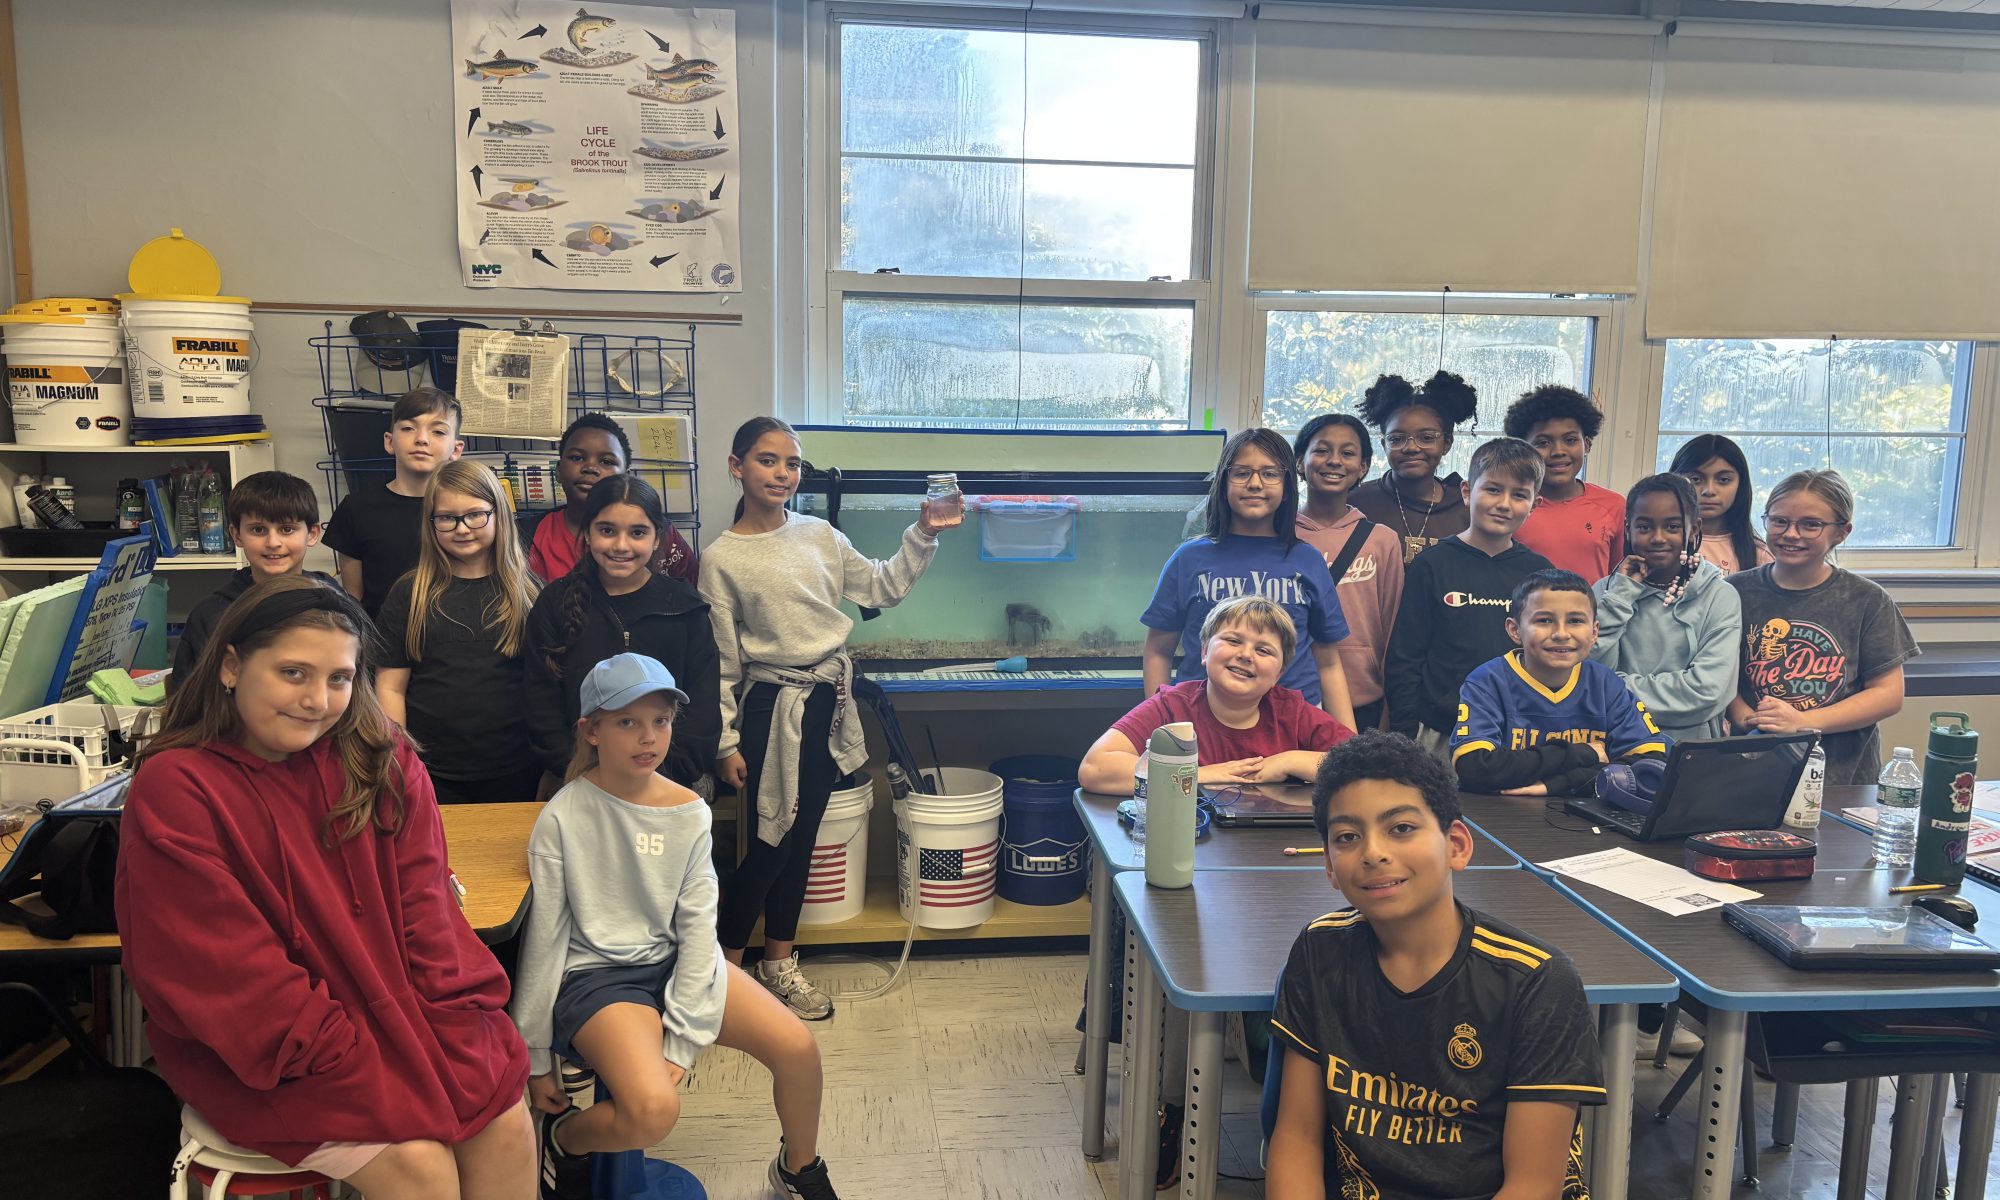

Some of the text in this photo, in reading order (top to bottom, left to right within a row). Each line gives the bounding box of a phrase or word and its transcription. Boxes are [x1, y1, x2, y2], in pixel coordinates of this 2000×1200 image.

[586, 126, 609, 135] LIFE
[581, 138, 616, 148] CYCLE
[601, 159, 628, 167] TROUT
[472, 264, 503, 275] NYC
[176, 340, 239, 353] FRABILL
[180, 357, 219, 366] AQUA
[35, 385, 99, 400] MAGNUM
[1198, 570, 1306, 605] New York
[102, 593, 119, 609] XPS
[1791, 627, 1832, 652] HAVE
[1745, 647, 1846, 687] The Day
[1789, 680, 1828, 695] YOU
[1456, 703, 1469, 737] 2
[635, 832, 665, 856] 95
[1326, 1054, 1480, 1118] Emirates
[1345, 1104, 1464, 1145] FLY BETTER
